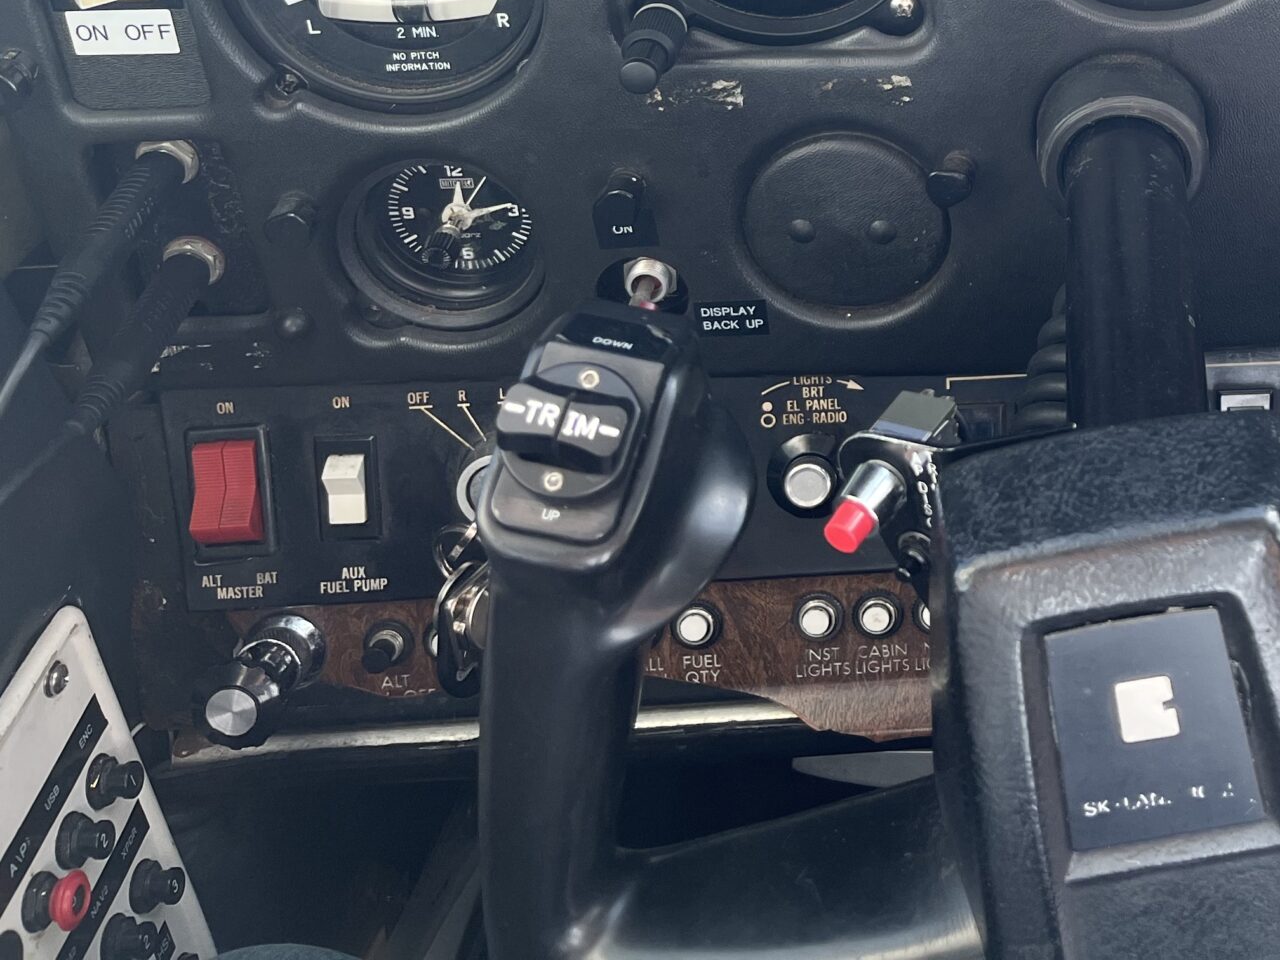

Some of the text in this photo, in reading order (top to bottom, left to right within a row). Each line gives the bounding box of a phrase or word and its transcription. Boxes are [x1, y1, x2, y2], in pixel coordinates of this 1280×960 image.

[75, 24, 172, 42] ON OFF
[397, 27, 439, 38] 2 MIN.
[410, 51, 439, 60] PITCH
[386, 62, 450, 72] INFORMATION
[701, 306, 756, 318] DISPLAY
[703, 318, 764, 330] BACK UP
[407, 391, 430, 405] OFF
[802, 386, 824, 398] BRT
[805, 399, 841, 411] PANEL
[320, 578, 388, 594] FUEL PUMP
[217, 586, 264, 600] MASTER
[858, 645, 908, 659] CABIN
[682, 654, 722, 669] FUEL
[855, 659, 910, 675] LIGHTS
